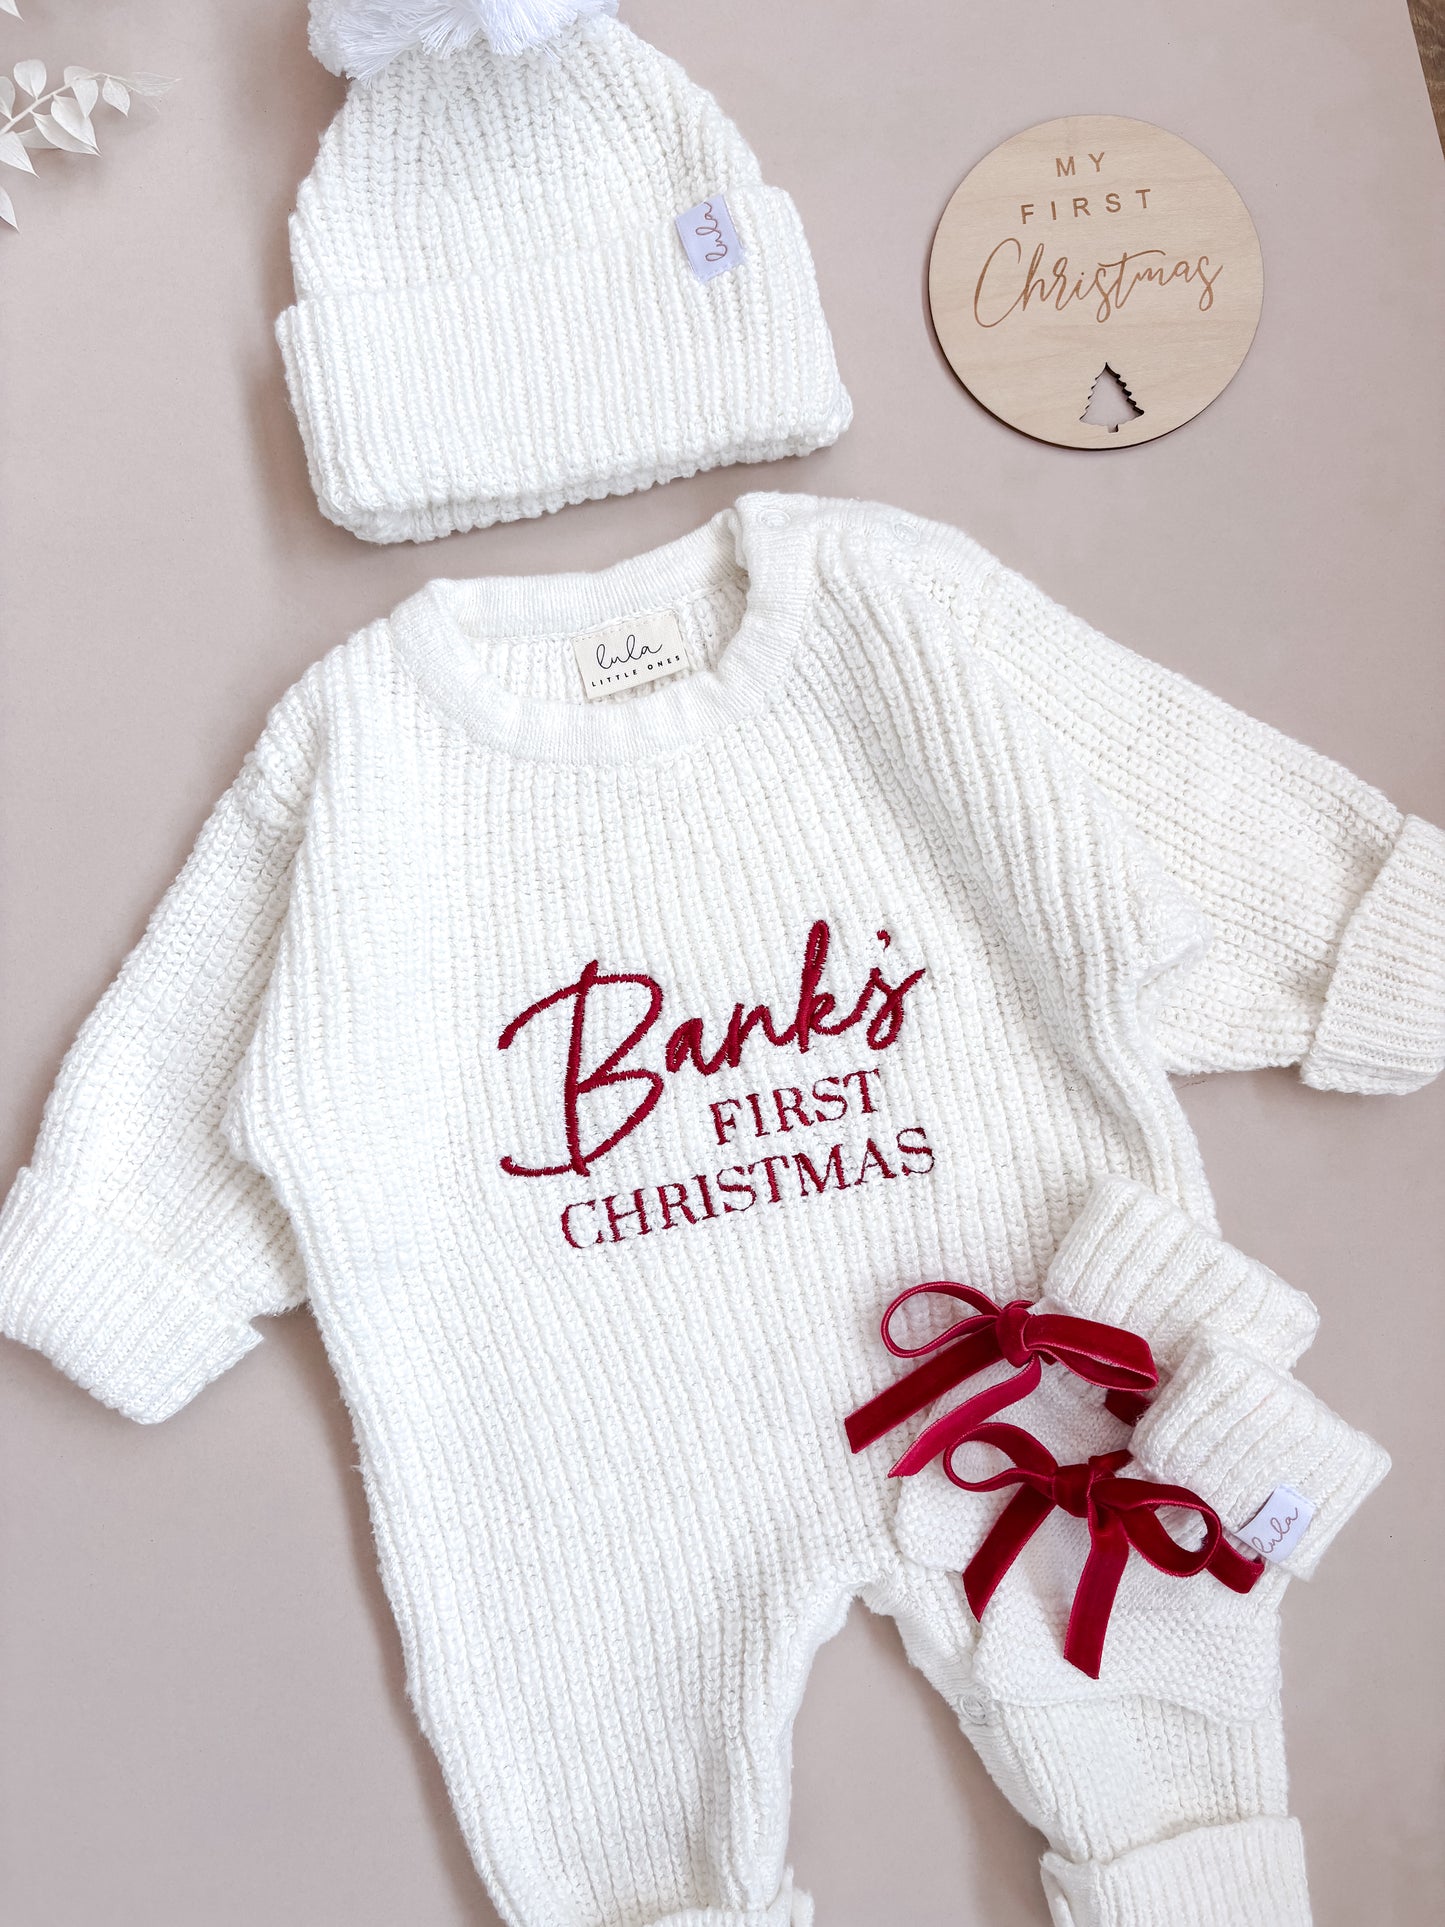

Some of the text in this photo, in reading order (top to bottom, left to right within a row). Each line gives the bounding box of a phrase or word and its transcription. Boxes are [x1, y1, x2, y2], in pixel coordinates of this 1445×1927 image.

[1055, 152, 1105, 177] MY
[1020, 188, 1151, 224] FIRST
[695, 201, 728, 262] lula
[974, 238, 1223, 328] Christmas
[591, 655, 680, 687] LITTLE ONES
[596, 634, 662, 669] lula
[709, 1068, 880, 1146] FIRST
[561, 1127, 935, 1250] CHRISTMAS
[1251, 1507, 1298, 1554] lula
